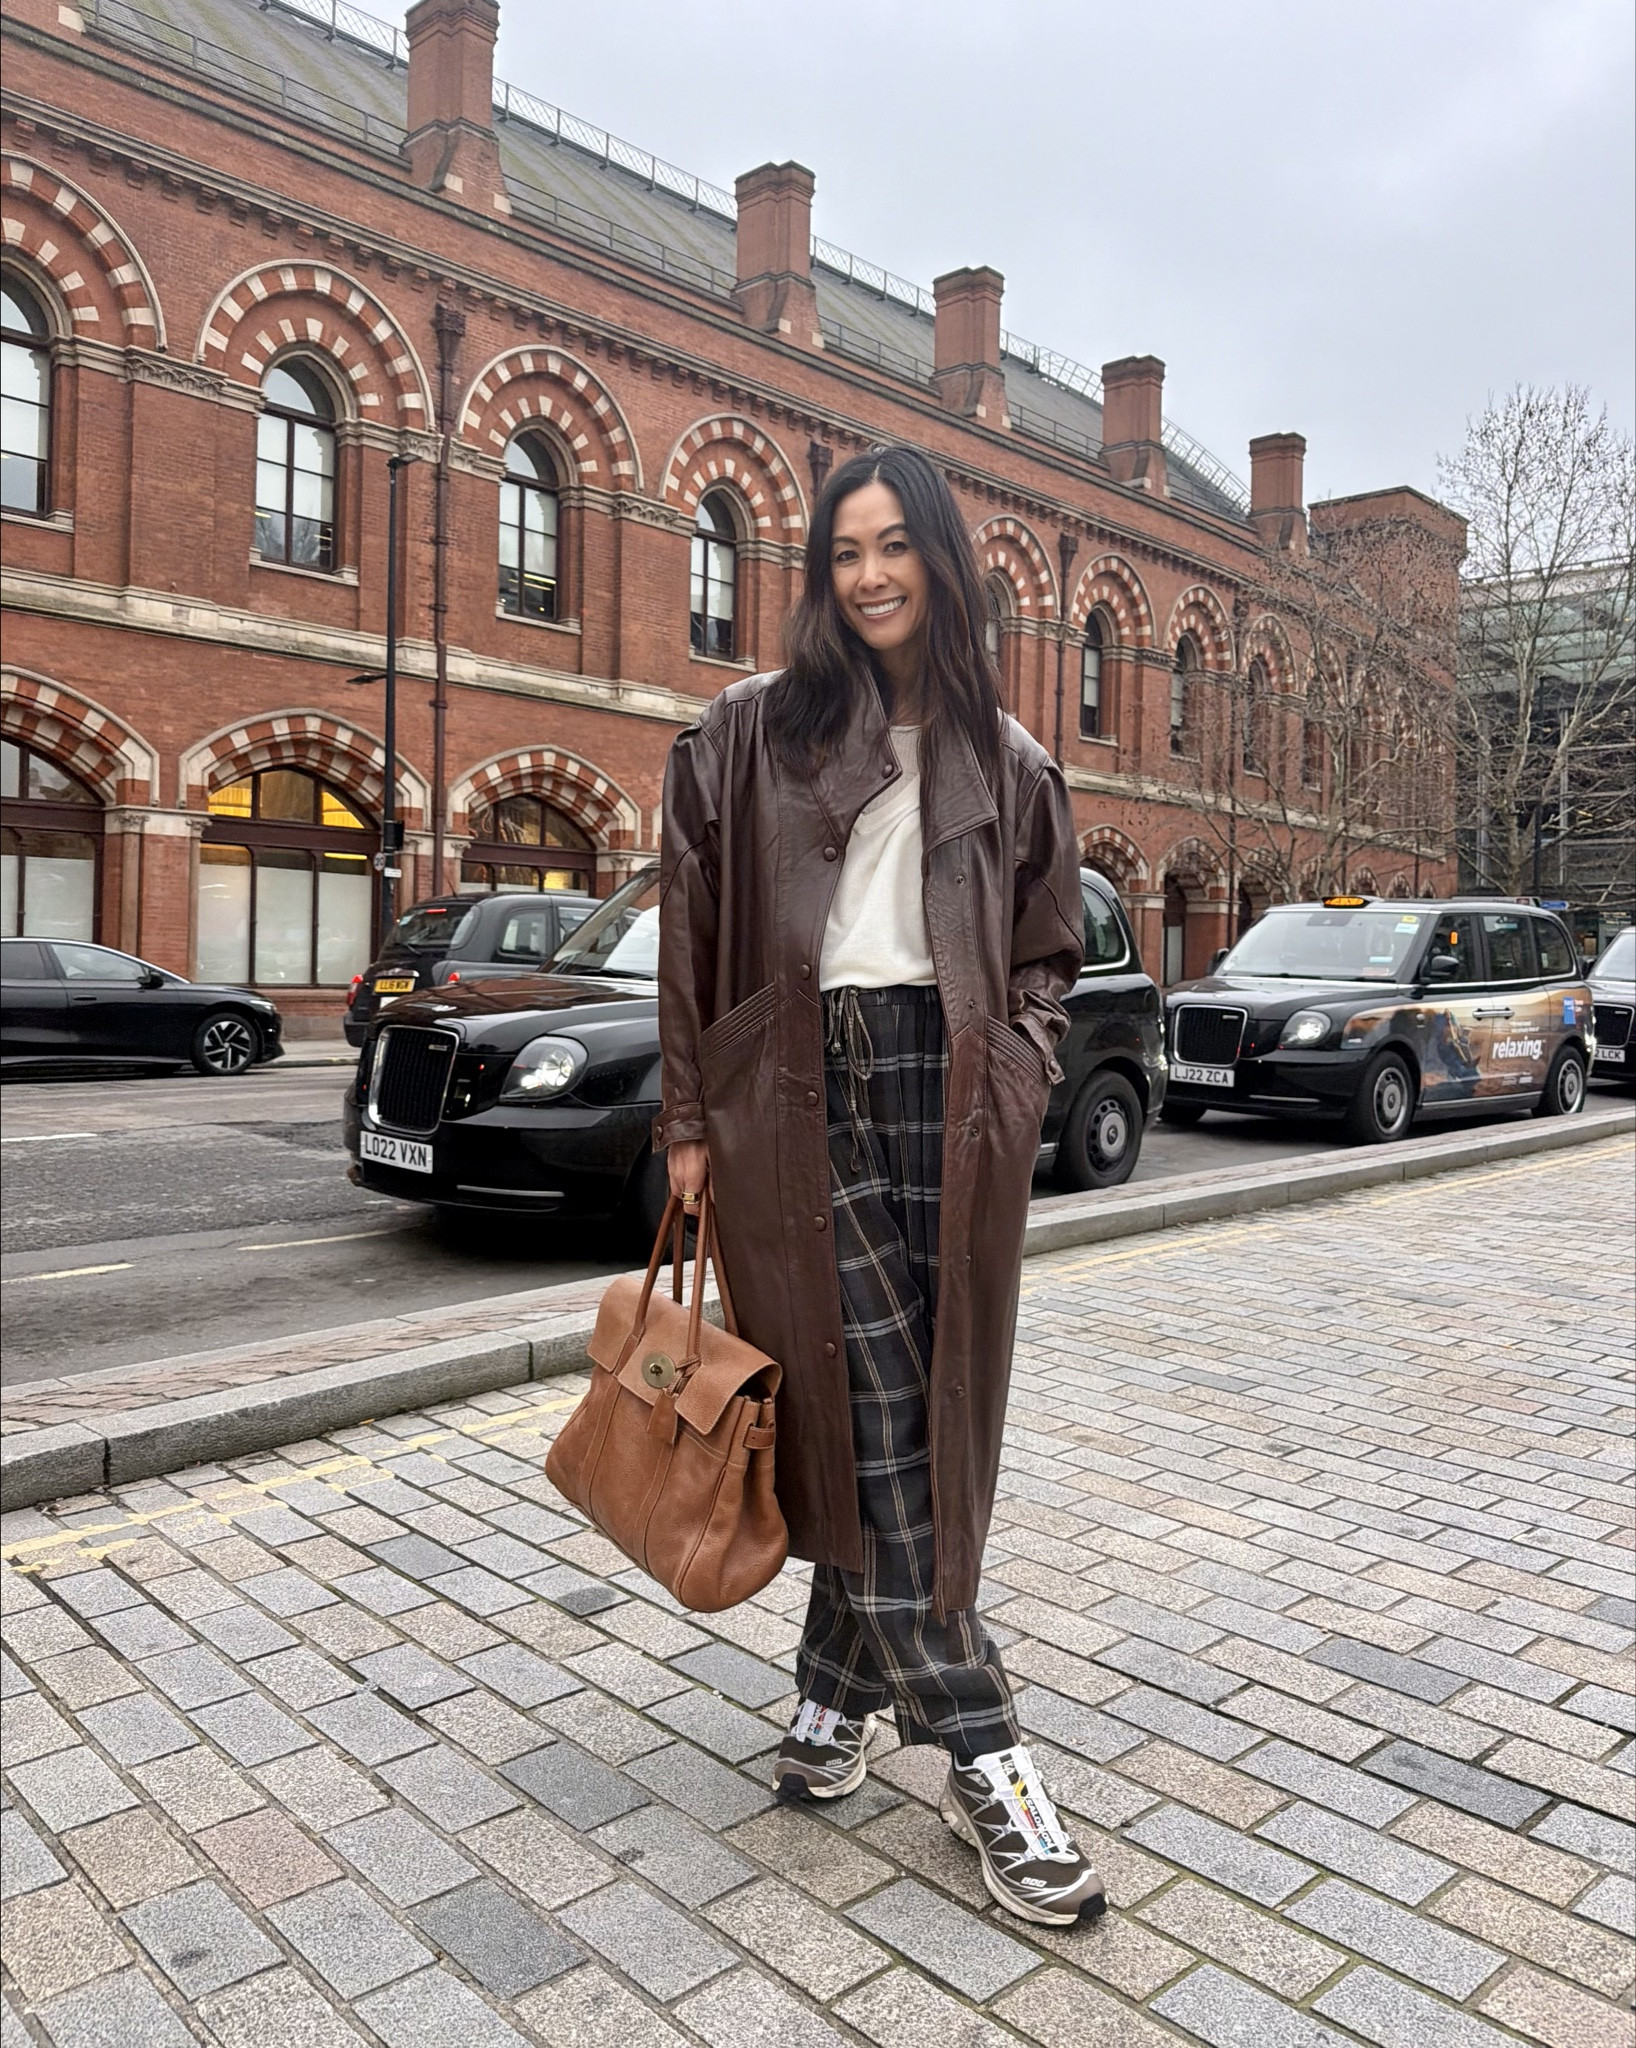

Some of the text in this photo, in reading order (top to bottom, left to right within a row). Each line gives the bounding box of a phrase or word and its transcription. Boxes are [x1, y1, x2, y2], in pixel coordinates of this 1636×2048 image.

[1602, 1050, 1621, 1060] LCK
[1174, 1066, 1229, 1084] LJ22 ZCA
[365, 1134, 427, 1167] LO22 VXN
